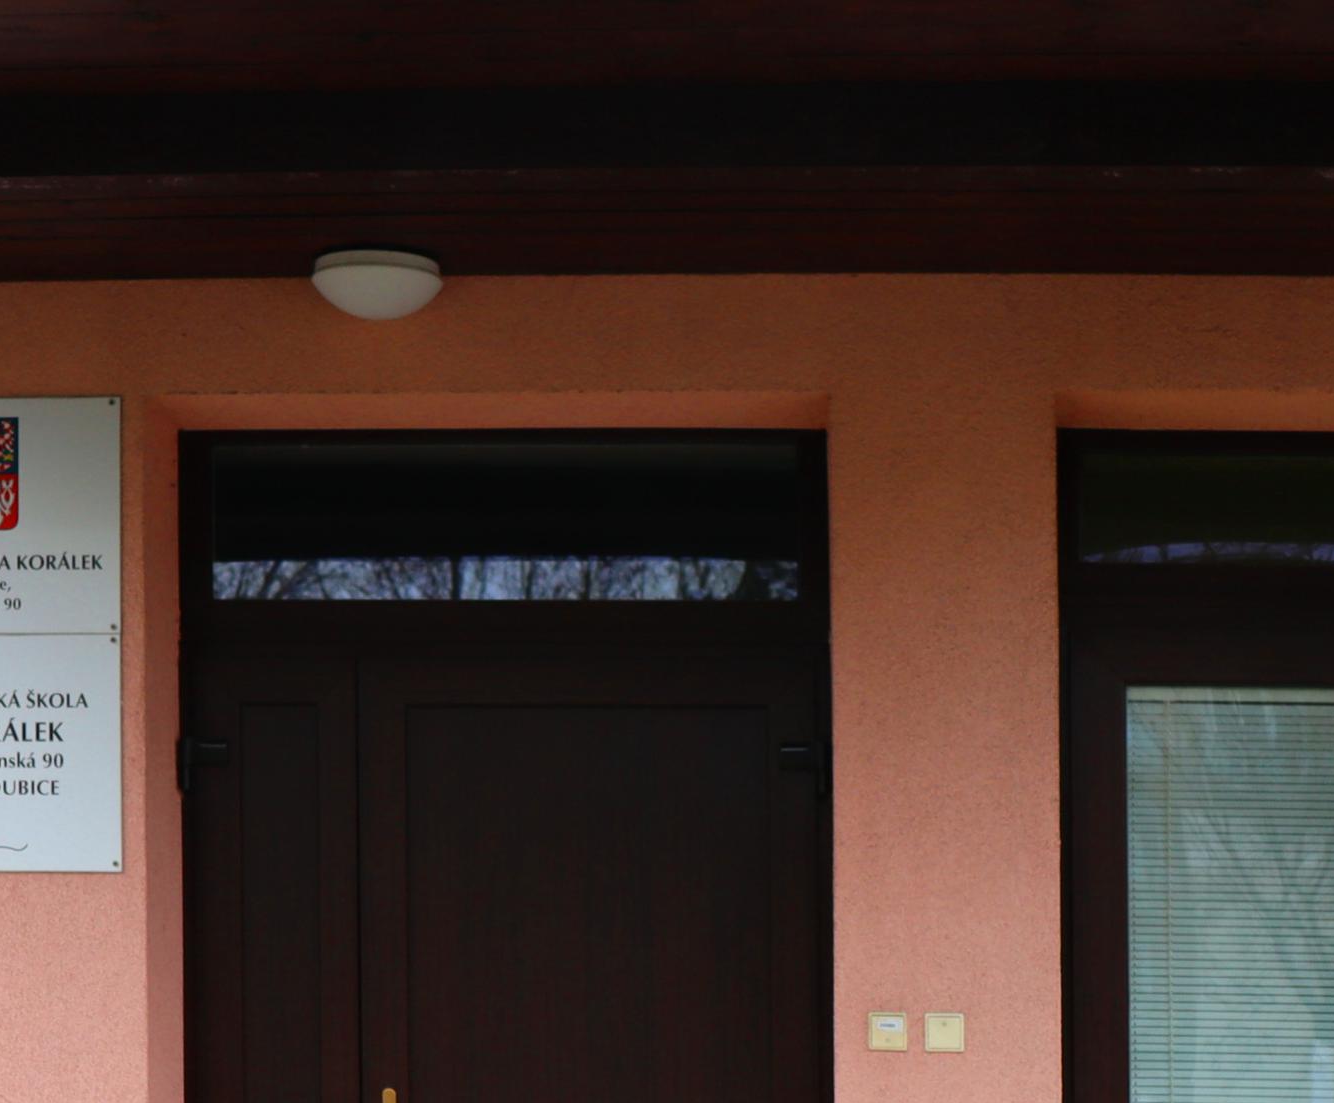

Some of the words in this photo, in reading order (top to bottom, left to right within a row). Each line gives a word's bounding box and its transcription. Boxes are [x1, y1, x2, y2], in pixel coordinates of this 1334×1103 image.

[17, 551, 103, 571] KORÁLEK
[4, 598, 21, 611] 90
[26, 689, 88, 708] ŠKOLA
[42, 753, 64, 769] 90
